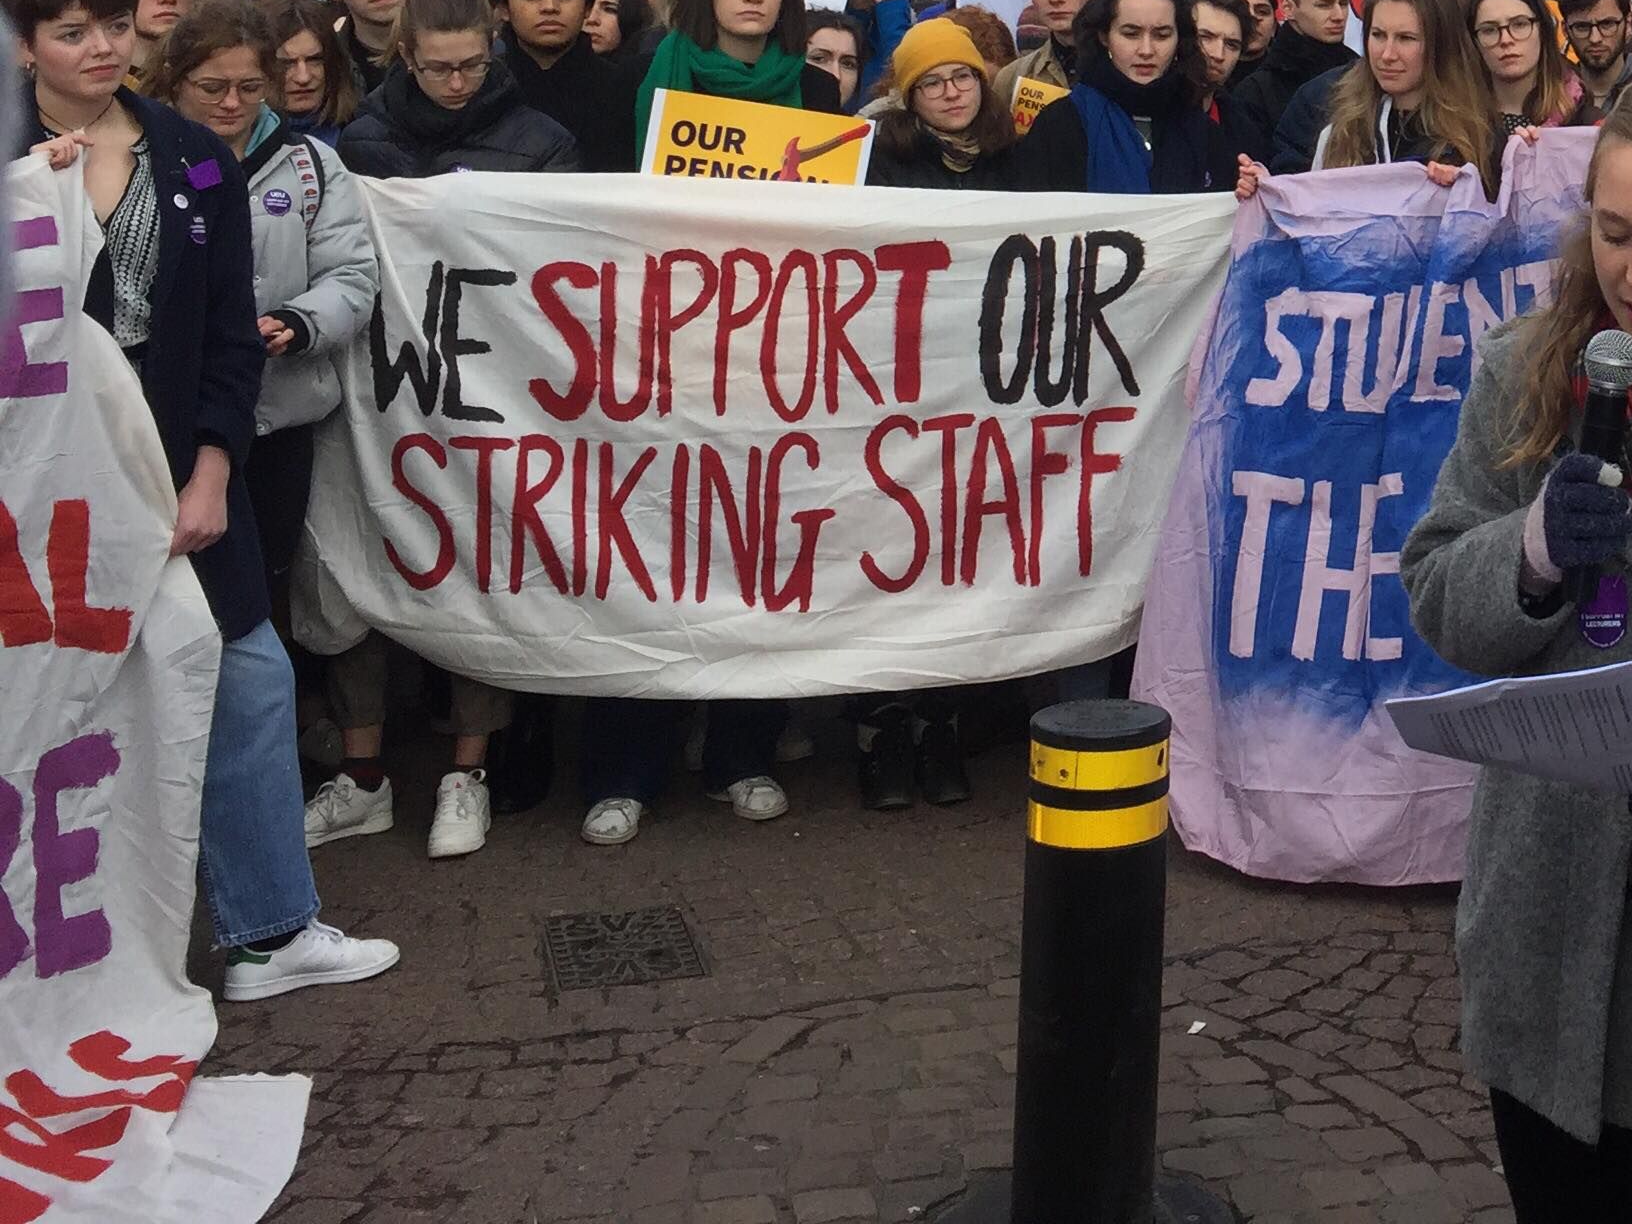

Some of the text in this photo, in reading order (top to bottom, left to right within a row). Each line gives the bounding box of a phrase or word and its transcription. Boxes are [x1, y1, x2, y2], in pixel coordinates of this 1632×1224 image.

[1017, 97, 1046, 111] PENS
[1020, 87, 1045, 100] OUR
[671, 120, 746, 155] OUR
[664, 154, 830, 183] PENS
[370, 231, 1145, 422] WE SUPPORT OUR
[384, 407, 1138, 614] STRIKING STAFF
